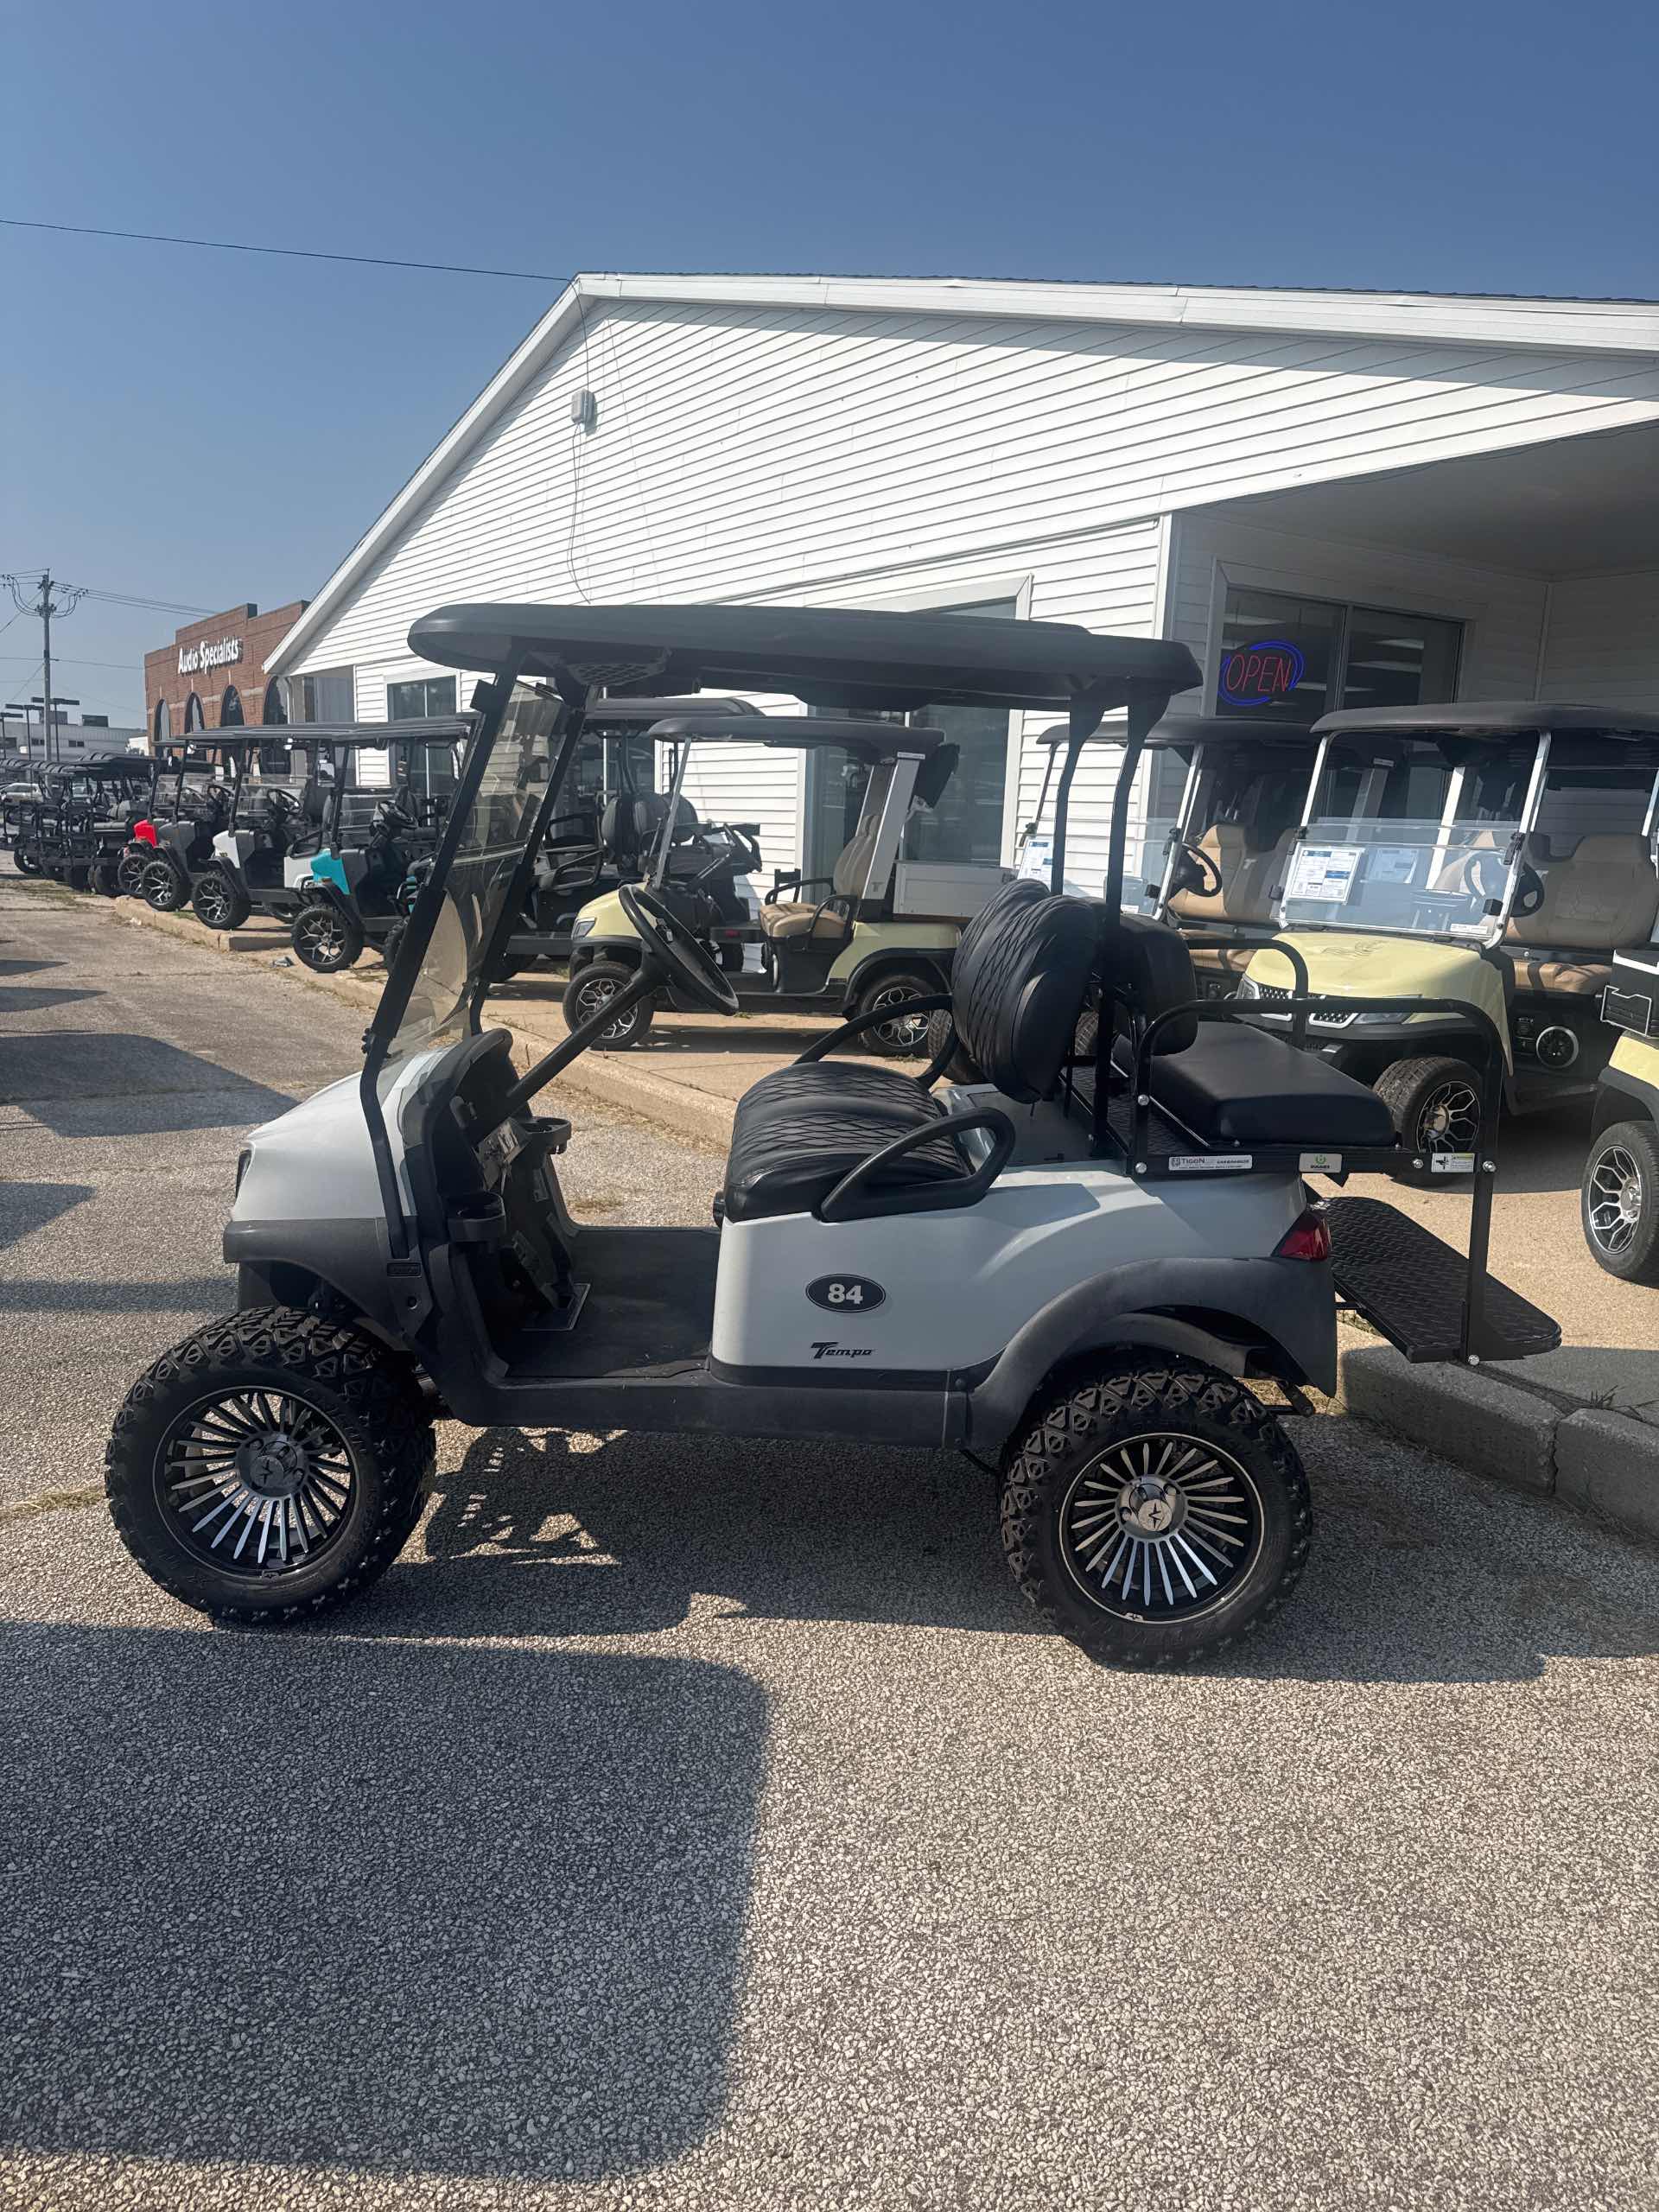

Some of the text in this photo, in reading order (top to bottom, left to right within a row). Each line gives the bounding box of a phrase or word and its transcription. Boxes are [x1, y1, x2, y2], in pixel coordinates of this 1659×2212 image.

[178, 636, 239, 675] Audio Specialists
[1227, 654, 1292, 692] OPEN
[827, 1283, 864, 1305] 84
[810, 1341, 873, 1360] Tempo
